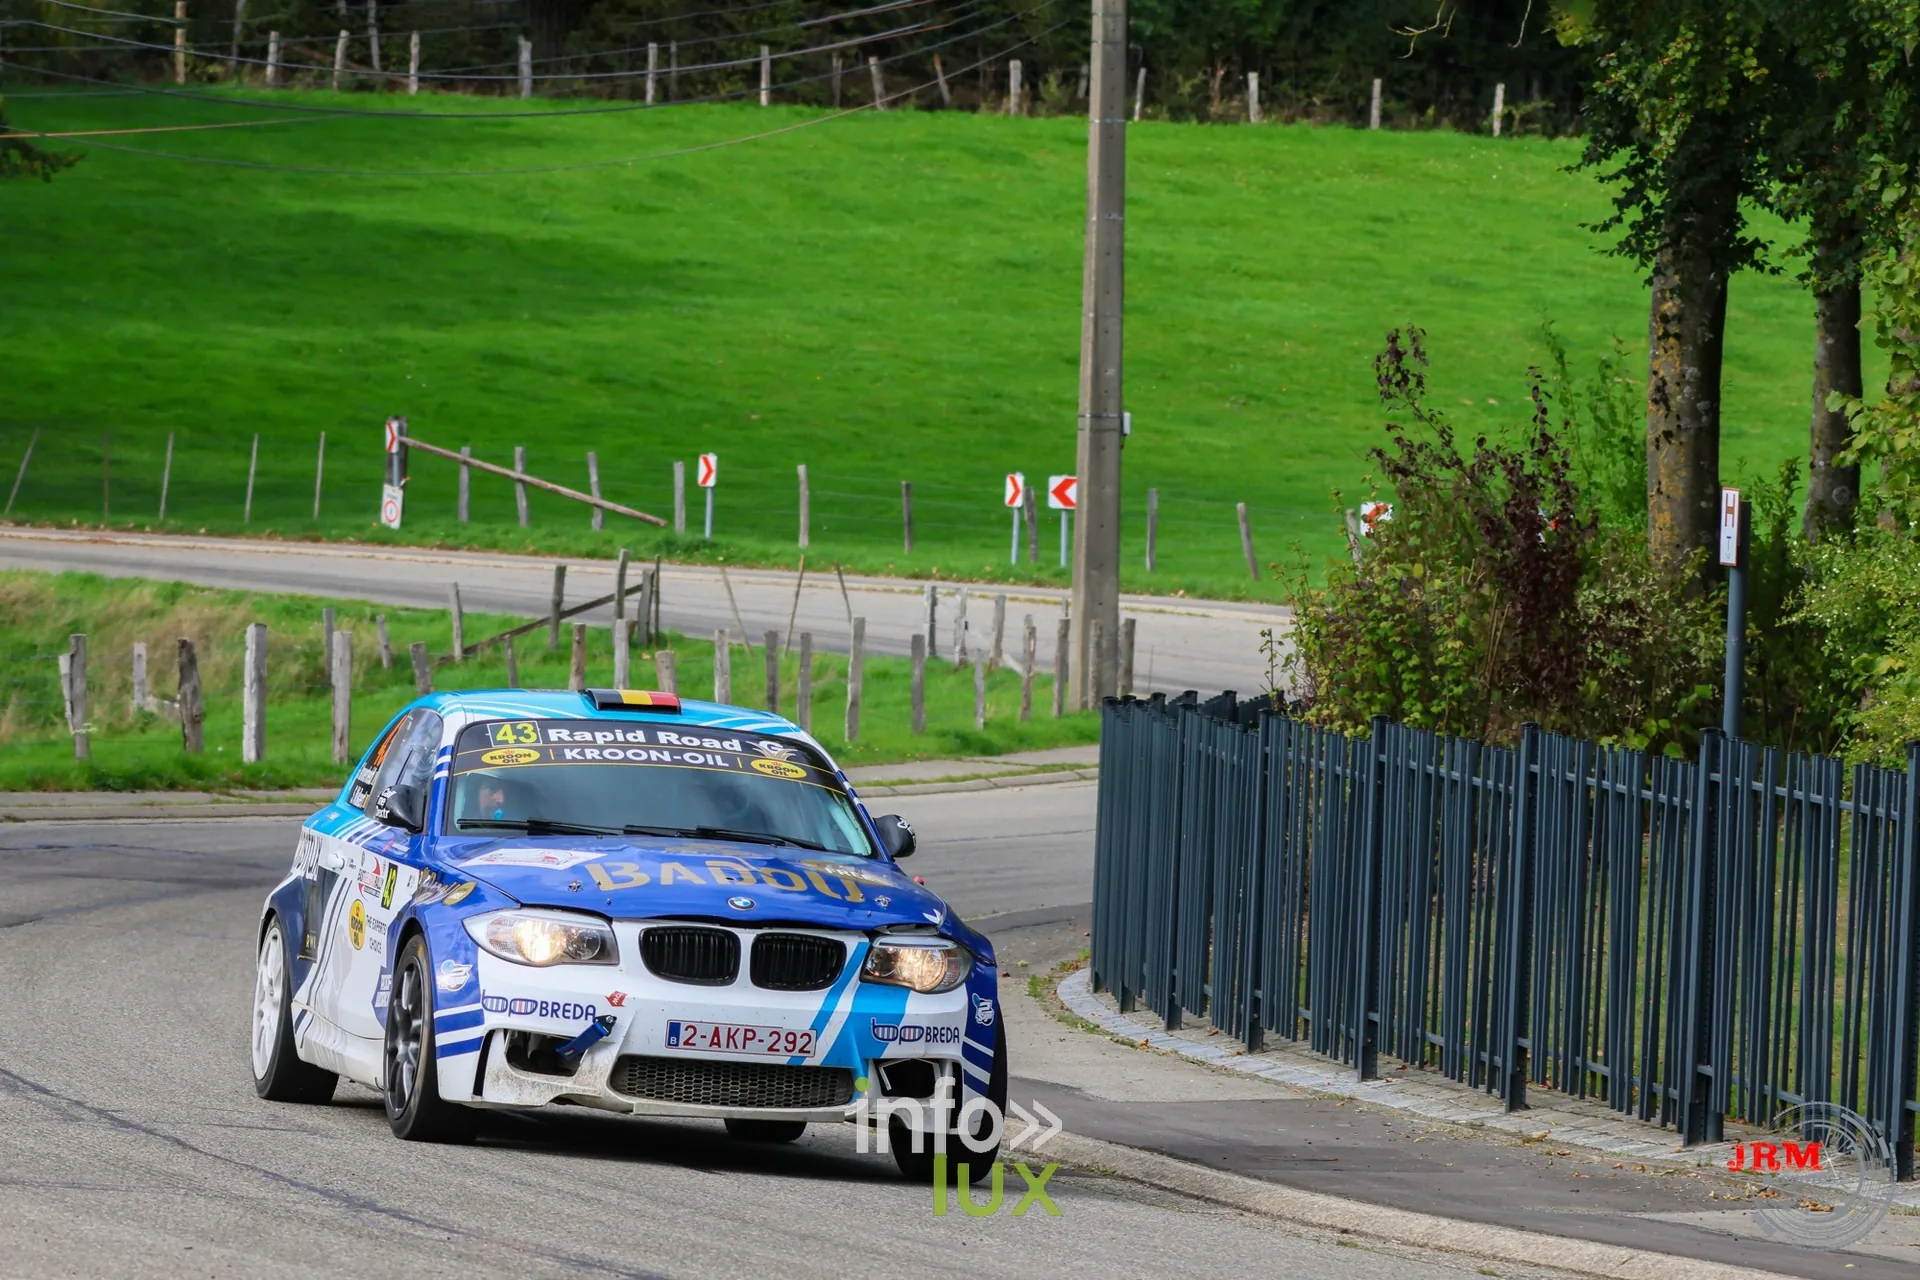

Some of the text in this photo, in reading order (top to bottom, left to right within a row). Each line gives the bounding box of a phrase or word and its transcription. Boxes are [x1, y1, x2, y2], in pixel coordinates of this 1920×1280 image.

[495, 722, 538, 744] 43
[547, 727, 742, 752] Rapid Road
[489, 752, 532, 761] KROON
[563, 747, 729, 768] KROON-OIL
[758, 763, 799, 774] KROON
[539, 1002, 597, 1021] BREDA
[670, 1036, 677, 1045] B
[682, 1024, 813, 1055] 2-AKP-292
[925, 1026, 960, 1044] BREDA
